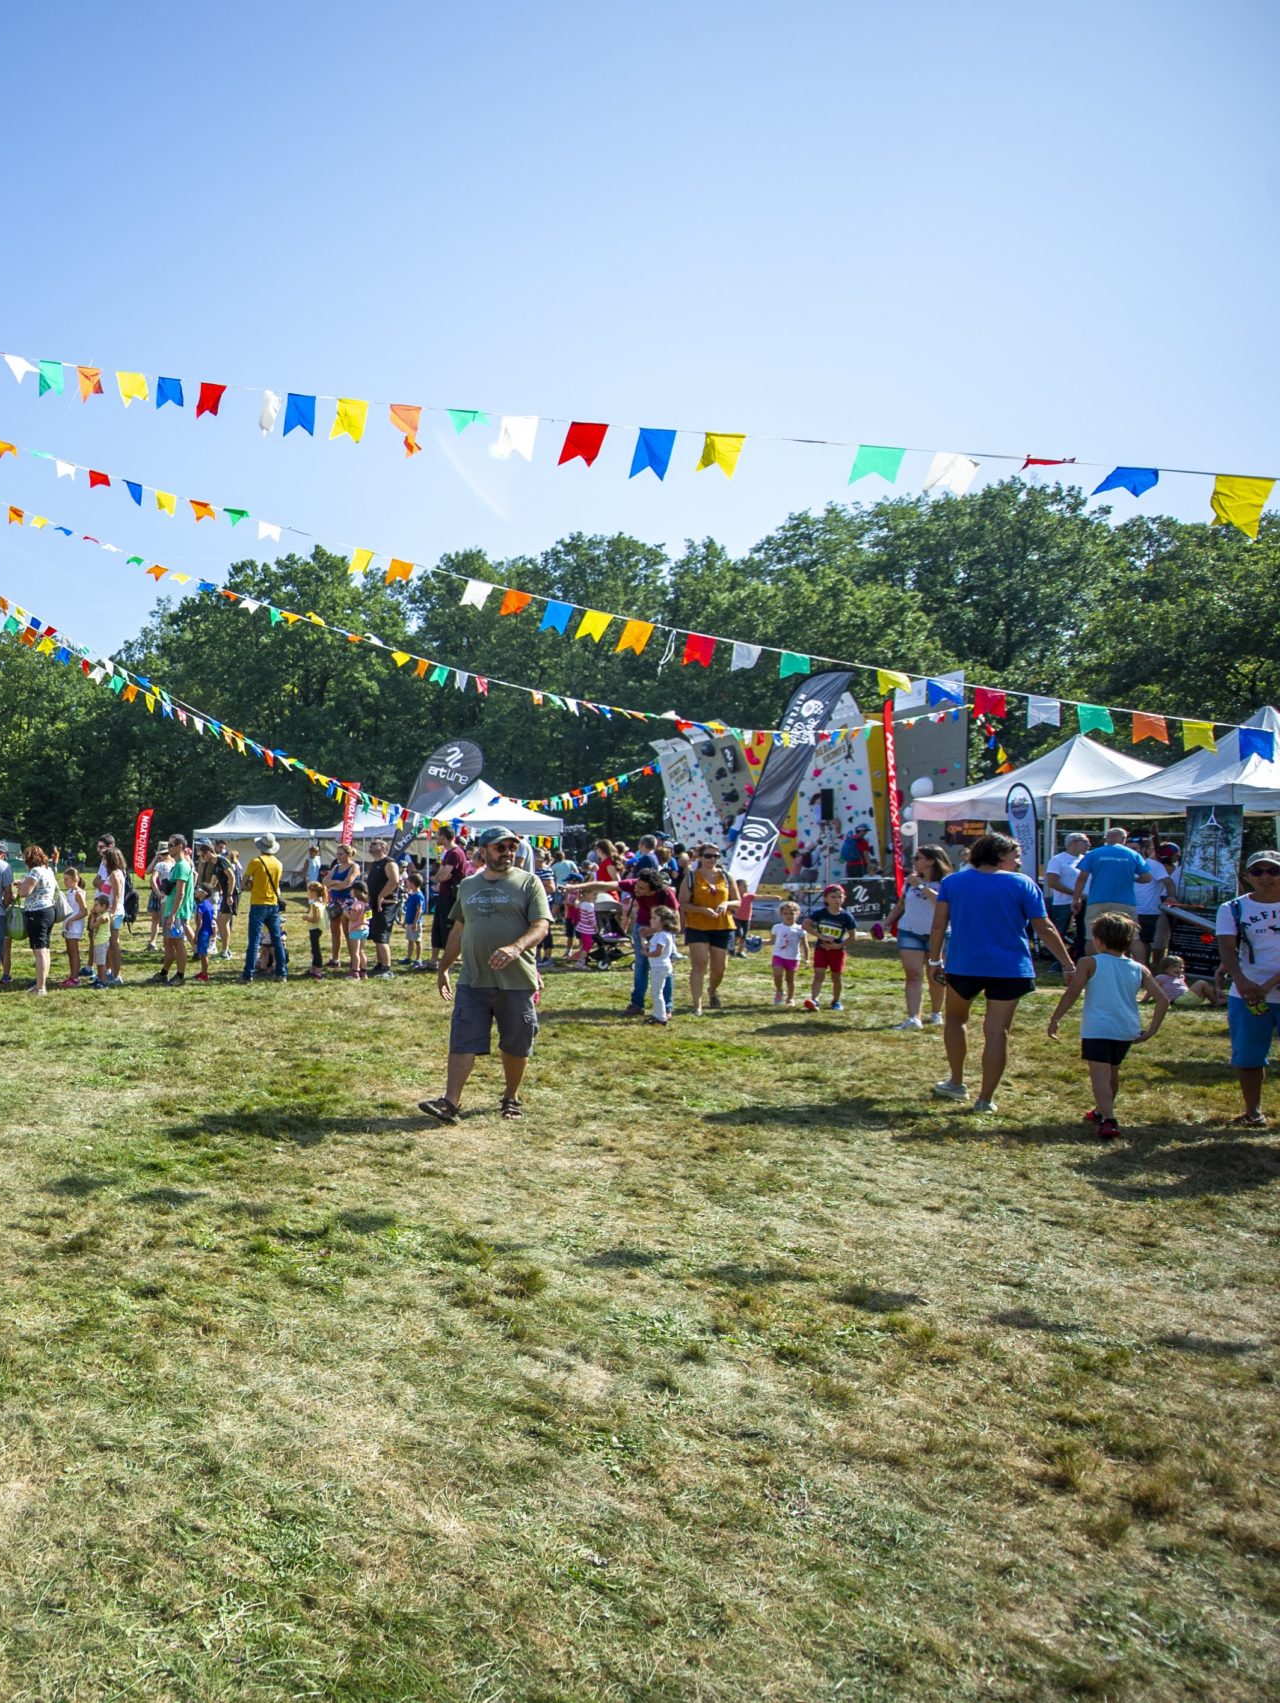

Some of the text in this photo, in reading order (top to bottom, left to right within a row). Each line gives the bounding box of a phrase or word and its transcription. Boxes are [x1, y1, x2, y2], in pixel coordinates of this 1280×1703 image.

[783, 693, 807, 731] UNTAIN
[427, 765, 469, 785] artline
[344, 797, 357, 845] ANDLYON
[137, 815, 150, 869] GRANDLYON
[846, 902, 881, 913] artline
